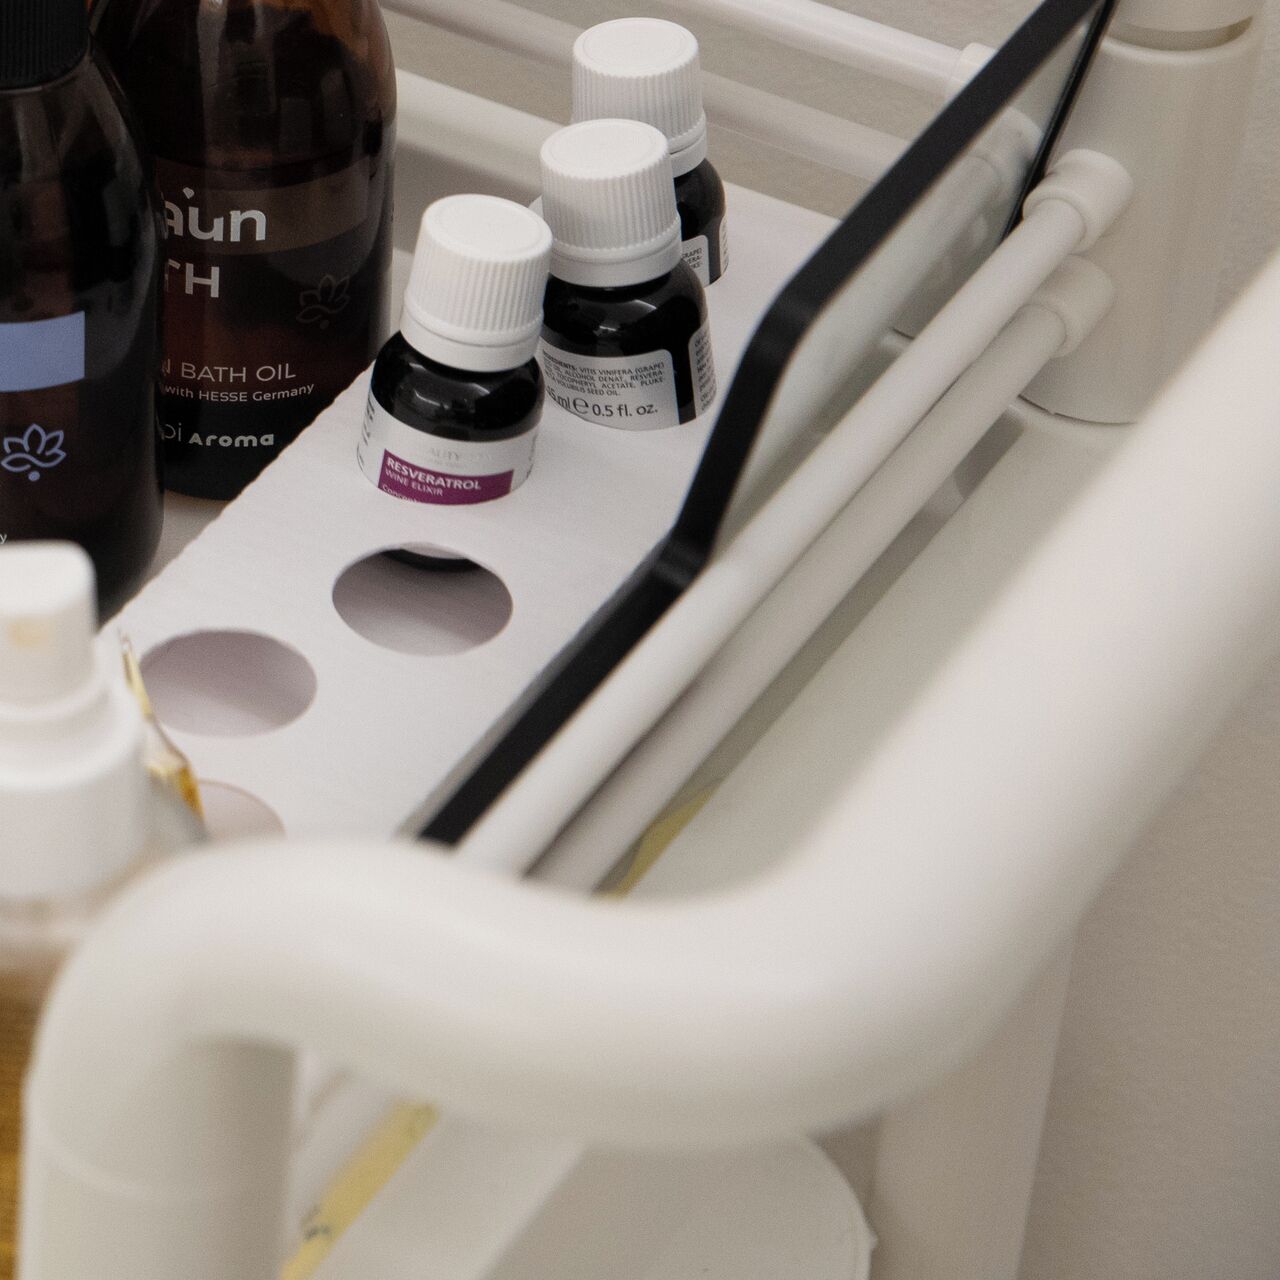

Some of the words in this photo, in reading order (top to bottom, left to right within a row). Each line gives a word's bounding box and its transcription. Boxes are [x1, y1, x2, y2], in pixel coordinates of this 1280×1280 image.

[182, 362, 246, 383] BATH
[256, 363, 296, 382] OIL
[579, 365, 596, 374] VITIS
[598, 368, 633, 376] VINIFERA
[165, 385, 194, 399] with
[199, 390, 247, 402] HESSE
[253, 384, 314, 402] Germany
[587, 388, 604, 396] SEED
[592, 404, 613, 417] 0.5
[617, 404, 632, 417] fl.
[636, 404, 658, 415] oz.
[189, 432, 274, 448] Aroma
[386, 457, 481, 490] RESVERATROL
[385, 470, 409, 486] WINE
[411, 478, 444, 497] ELIXIR
